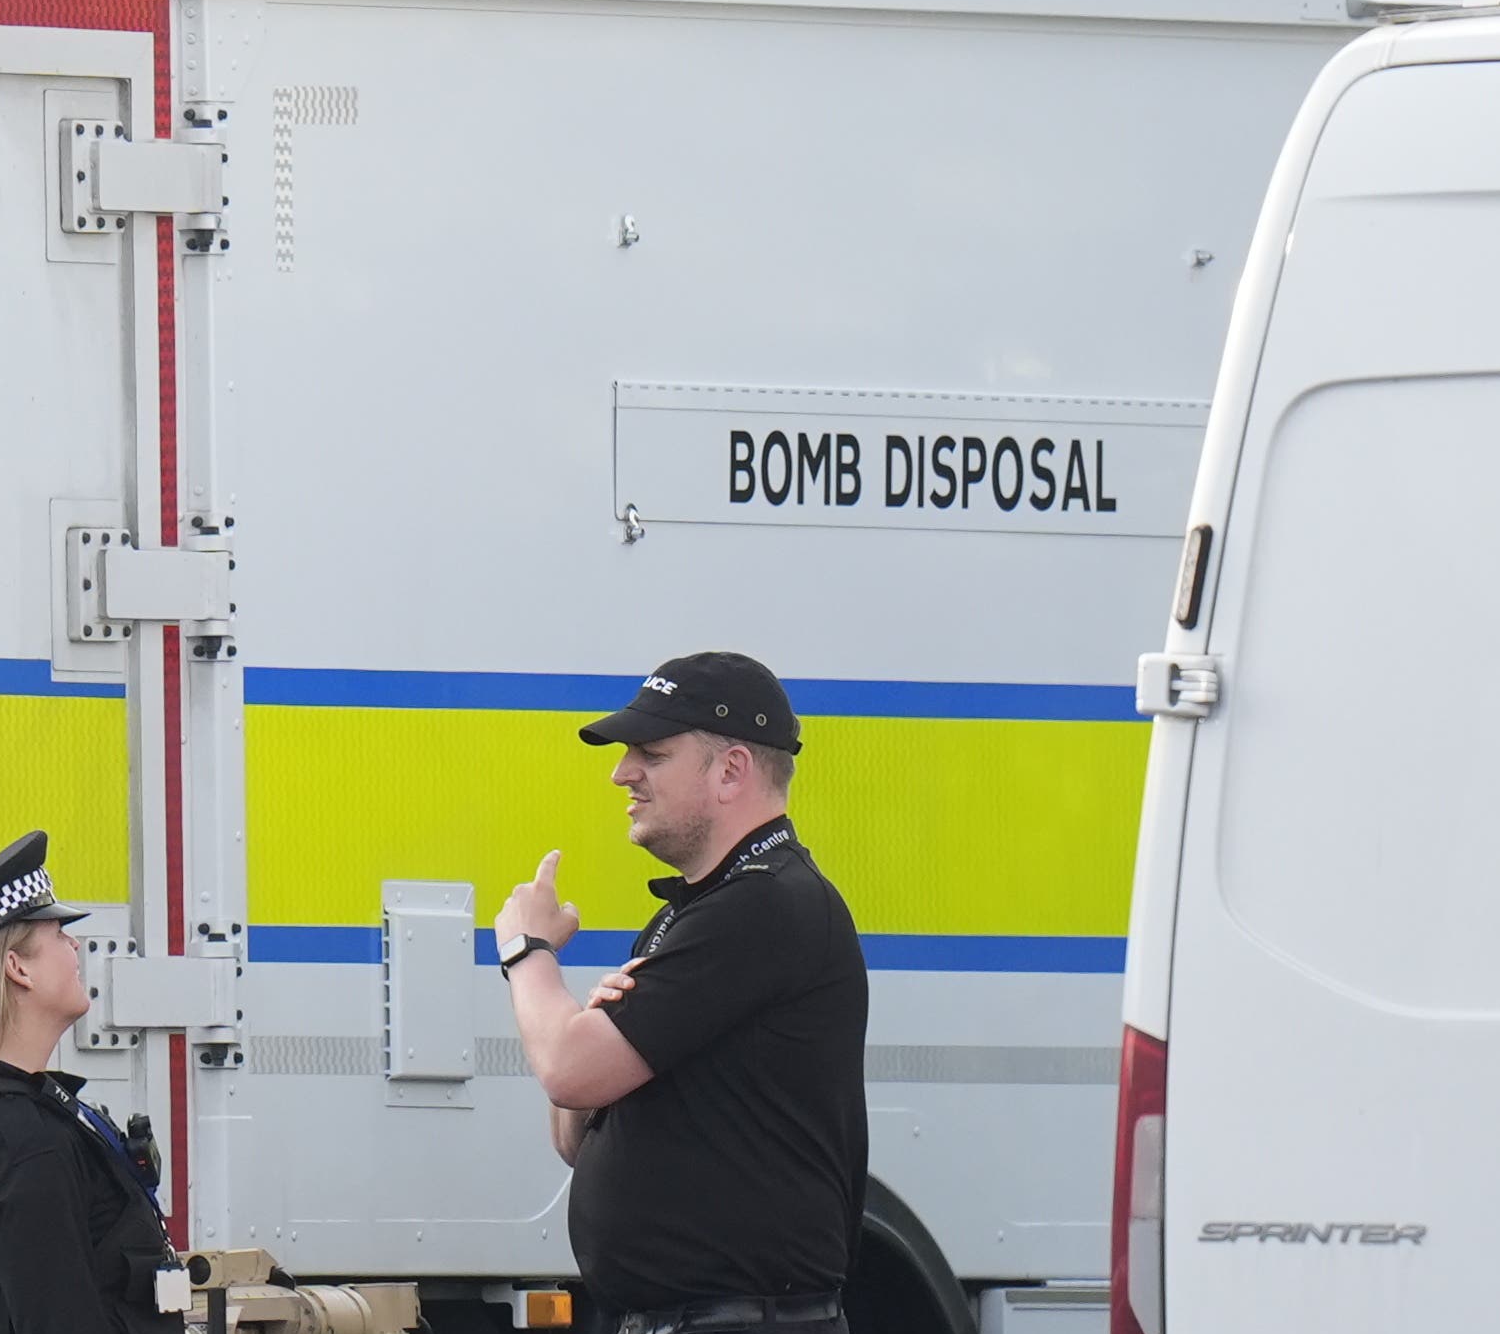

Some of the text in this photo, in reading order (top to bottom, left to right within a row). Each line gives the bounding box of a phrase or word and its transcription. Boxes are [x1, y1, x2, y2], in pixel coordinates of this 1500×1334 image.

[729, 430, 1117, 512] BOMB DISPOSAL
[1197, 1221, 1427, 1246] SPRINTER
